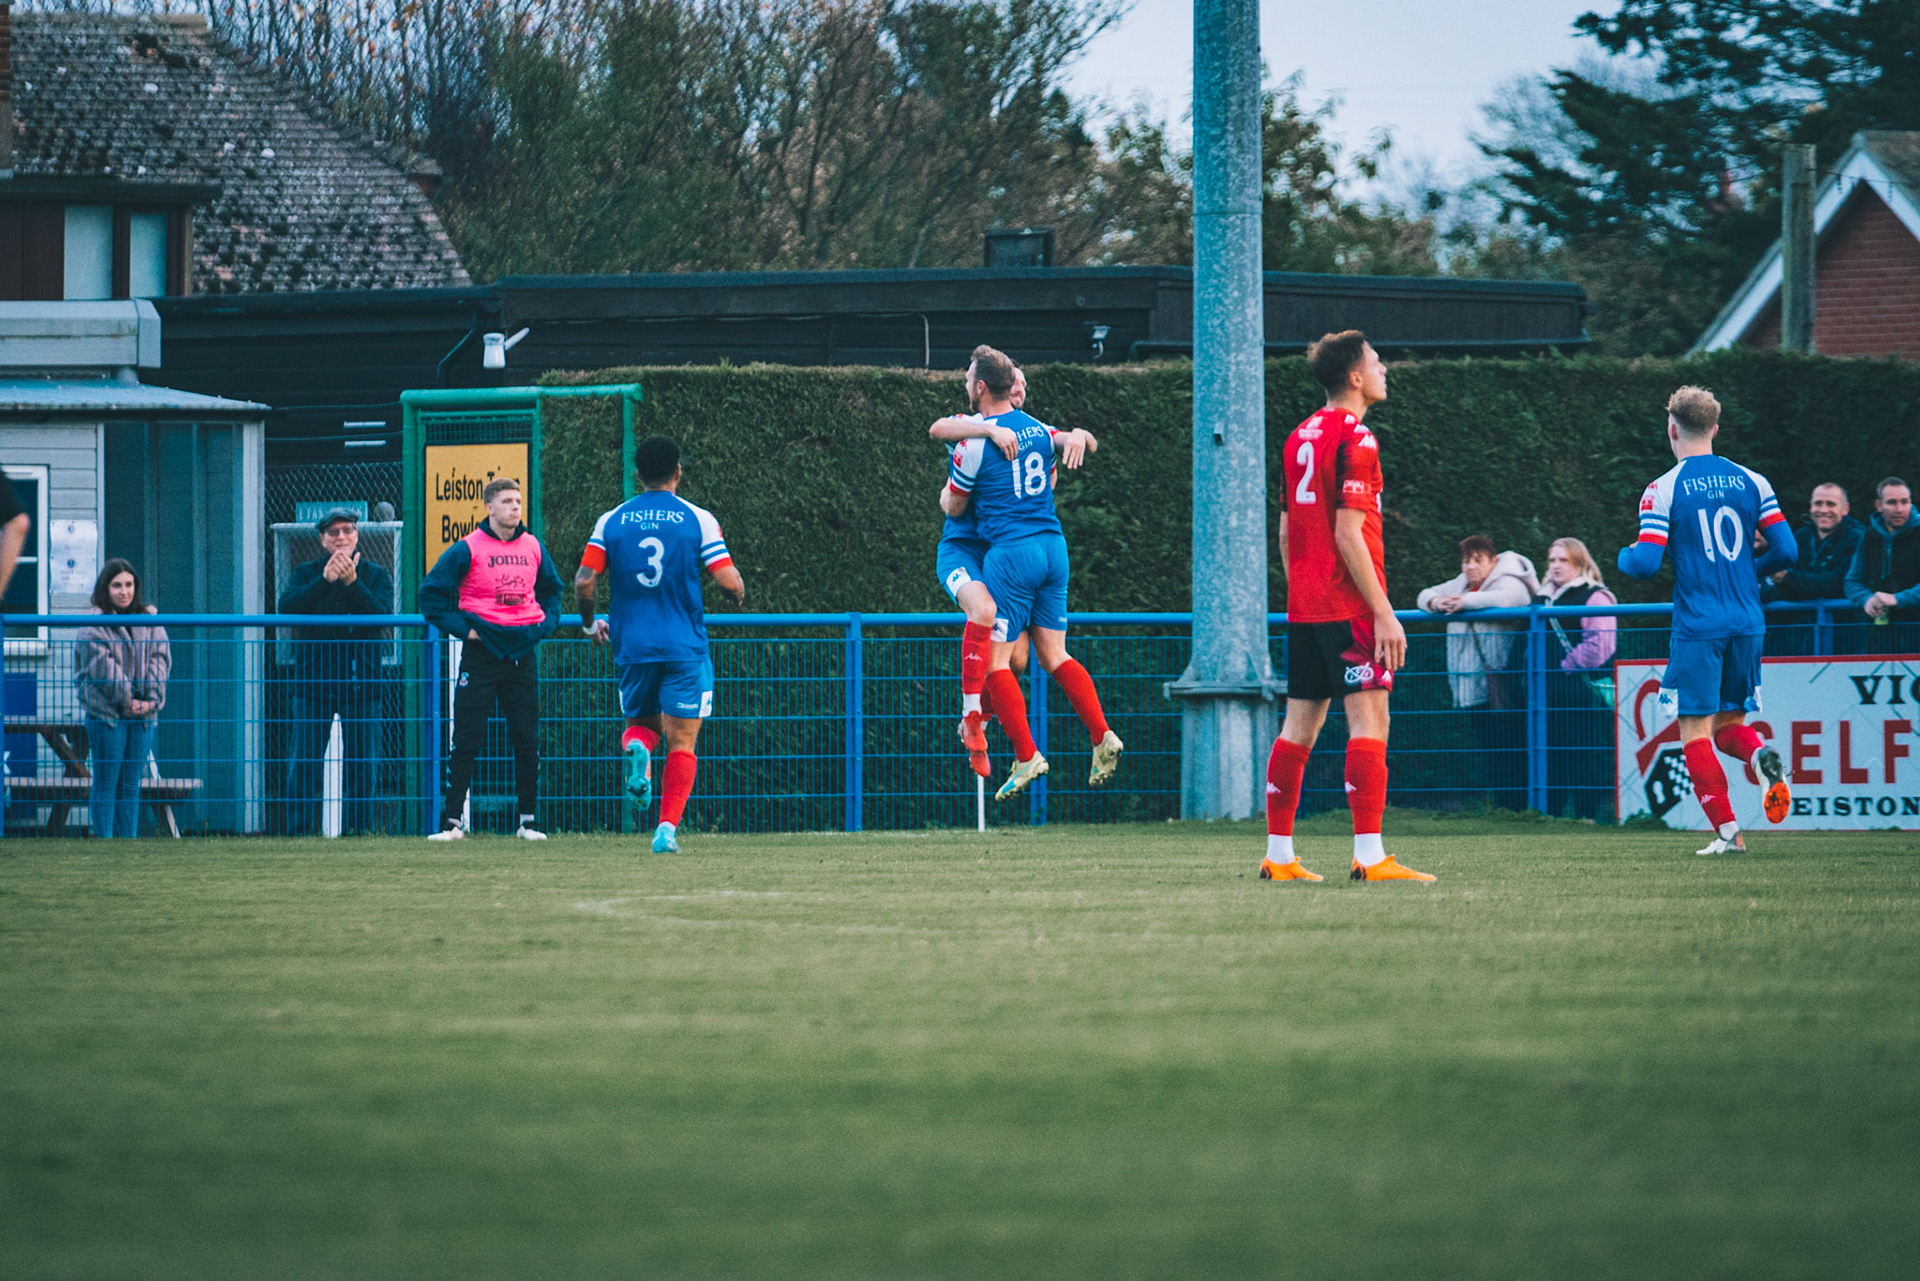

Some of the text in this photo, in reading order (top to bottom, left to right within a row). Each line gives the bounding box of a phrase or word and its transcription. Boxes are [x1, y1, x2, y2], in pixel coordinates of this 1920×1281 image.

[1016, 426, 1044, 441] HERS
[1018, 439, 1033, 450] GIN
[436, 467, 483, 500] Leiston
[1012, 452, 1046, 499] 18
[1296, 441, 1317, 505] 2
[1683, 475, 1745, 496] FISHERS
[1707, 490, 1724, 499] GIN
[621, 509, 685, 525] FISHERS
[640, 522, 659, 531] GIN
[442, 514, 481, 543] Bowl
[1698, 506, 1743, 563] 10
[636, 536, 665, 588] 3
[1790, 796, 1920, 816] EISTON
